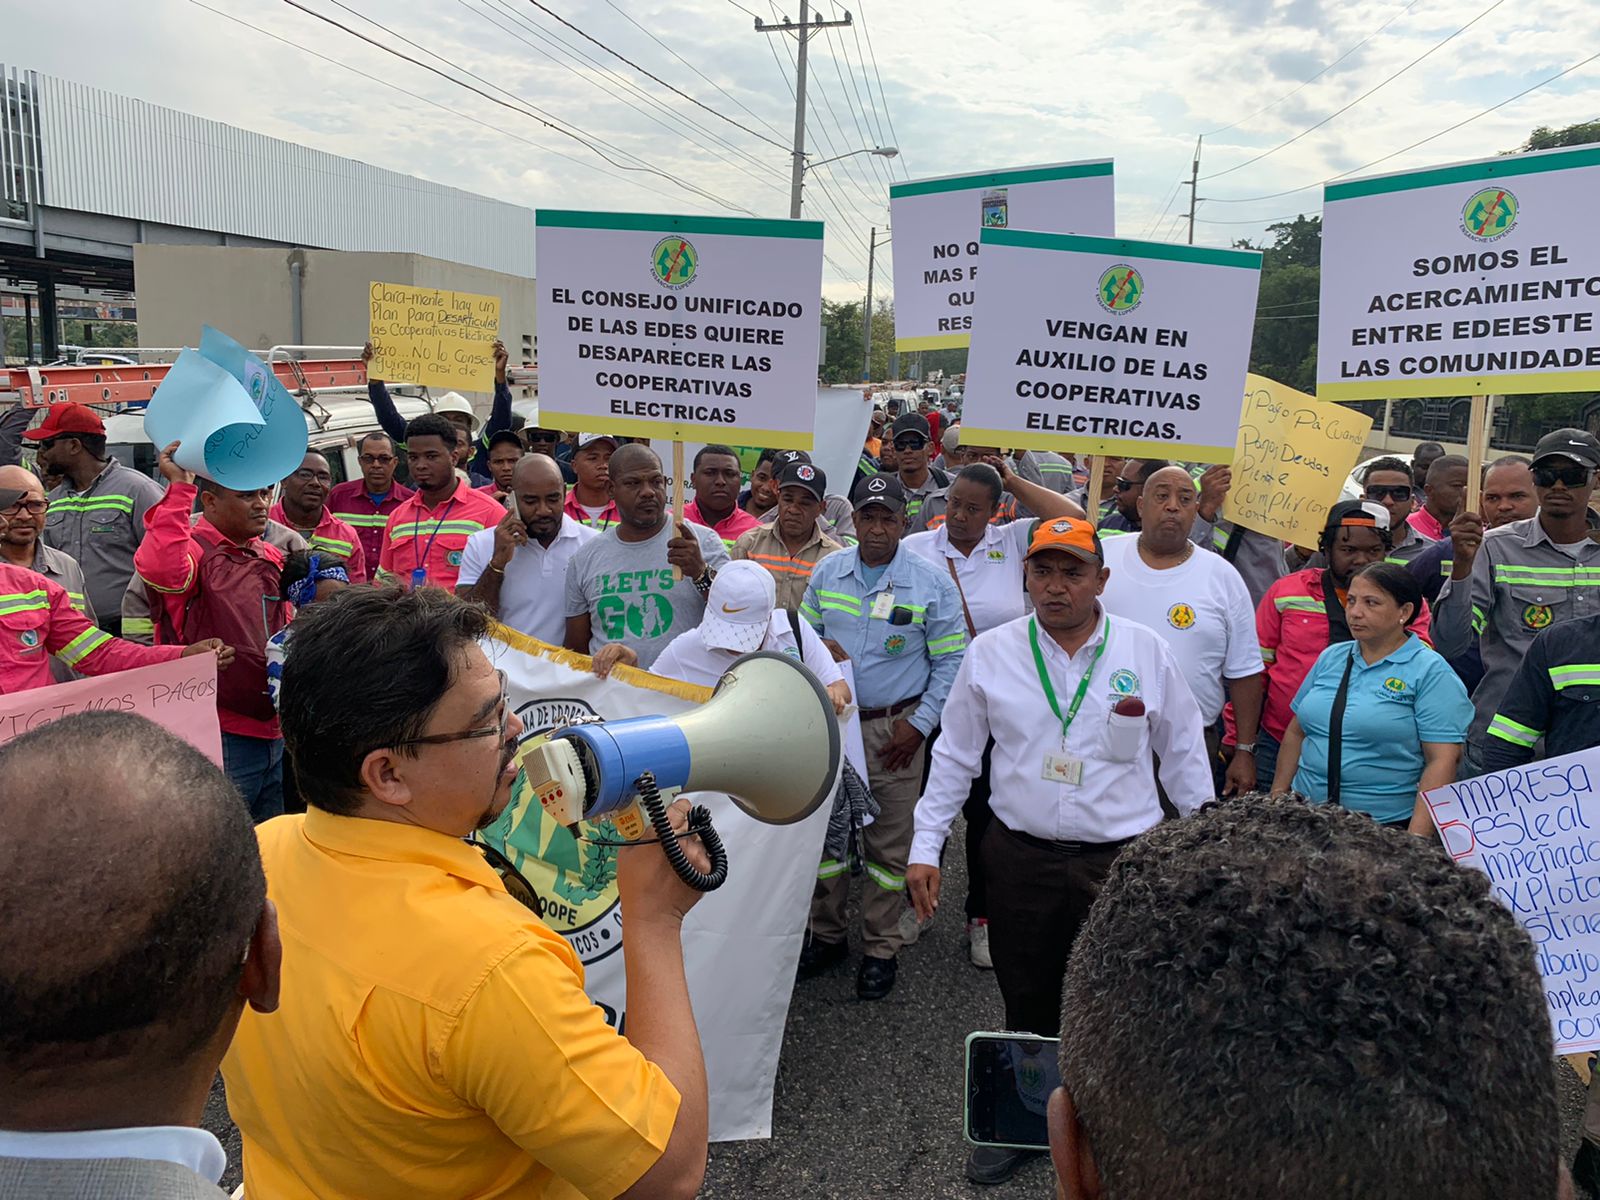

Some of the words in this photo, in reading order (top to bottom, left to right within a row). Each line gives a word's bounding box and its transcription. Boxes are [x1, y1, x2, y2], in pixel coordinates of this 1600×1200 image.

[933, 243, 960, 259] NO
[966, 241, 980, 256] Q
[1412, 249, 1519, 277] SOMOS
[1530, 245, 1568, 267] EL
[924, 267, 963, 285] MAS
[969, 266, 978, 280] P
[451, 292, 471, 313] hay
[479, 301, 495, 314] un
[552, 287, 576, 304] EL
[581, 289, 677, 311] CONSEJO
[684, 296, 803, 319] UNIFICADO
[948, 291, 975, 307] QU
[1367, 276, 1600, 314] ACERCAMIENTO
[371, 302, 399, 320] Plan
[938, 315, 973, 331] RES
[568, 316, 594, 333] DE
[600, 318, 639, 335] LAS
[644, 320, 698, 340] EDES
[703, 325, 784, 346] QUIERE
[1045, 319, 1148, 345] VENGAN
[1155, 329, 1188, 347] EN
[1351, 323, 1442, 347] ENTRE
[1452, 312, 1593, 340] EDEESTE
[578, 343, 725, 369] DESAPARECER
[731, 354, 772, 372] LAS
[1015, 349, 1116, 373] AUXILIO
[1123, 357, 1155, 377] DE
[1162, 361, 1208, 381] LAS
[1341, 359, 1390, 378] LAS
[1399, 347, 1600, 375] COMUNIDADE
[595, 371, 752, 398] COOPERATIVAS
[1015, 380, 1201, 411] COOPERATIVAS
[610, 399, 736, 424] ELECTRICAS
[1026, 412, 1182, 440] ELECTRICAS.
[601, 569, 674, 594] LET'S
[597, 593, 673, 640] GO
[537, 706, 549, 727] DE
